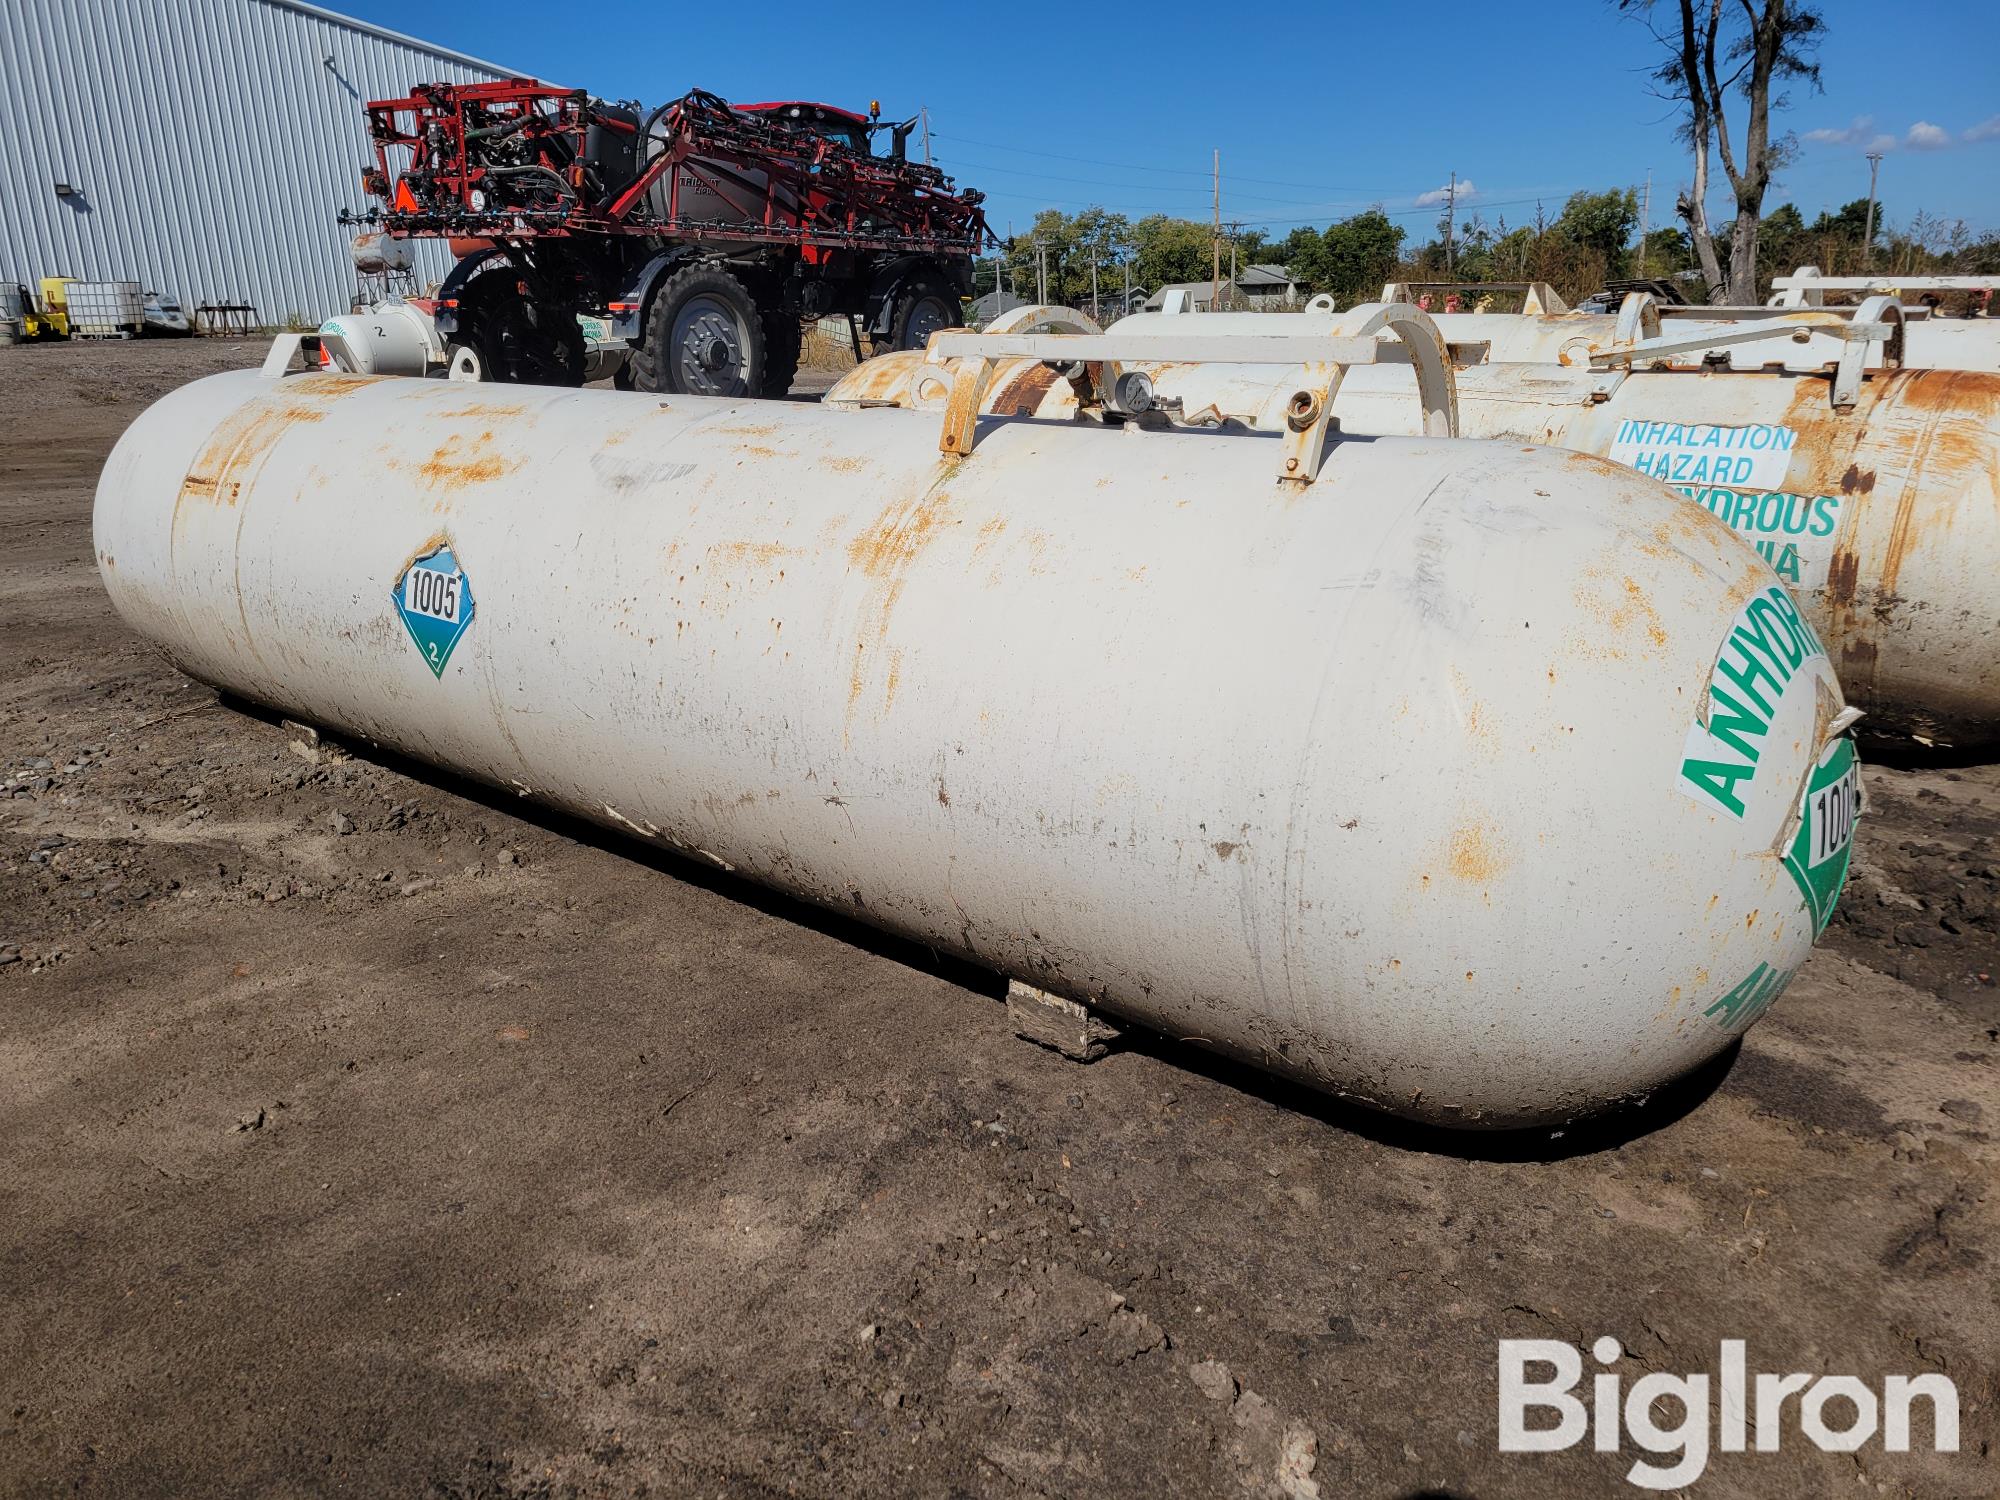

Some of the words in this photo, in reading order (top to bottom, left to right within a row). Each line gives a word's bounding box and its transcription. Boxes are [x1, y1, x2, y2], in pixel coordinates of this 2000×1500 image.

[374, 326, 386, 337] 2
[1617, 420, 1795, 450] INHALATION
[1633, 451, 1754, 484] HAZARD
[413, 569, 457, 619] 1005
[429, 641, 439, 663] 2
[1681, 587, 1825, 819] ANHYDR
[1817, 772, 1854, 859] 100
